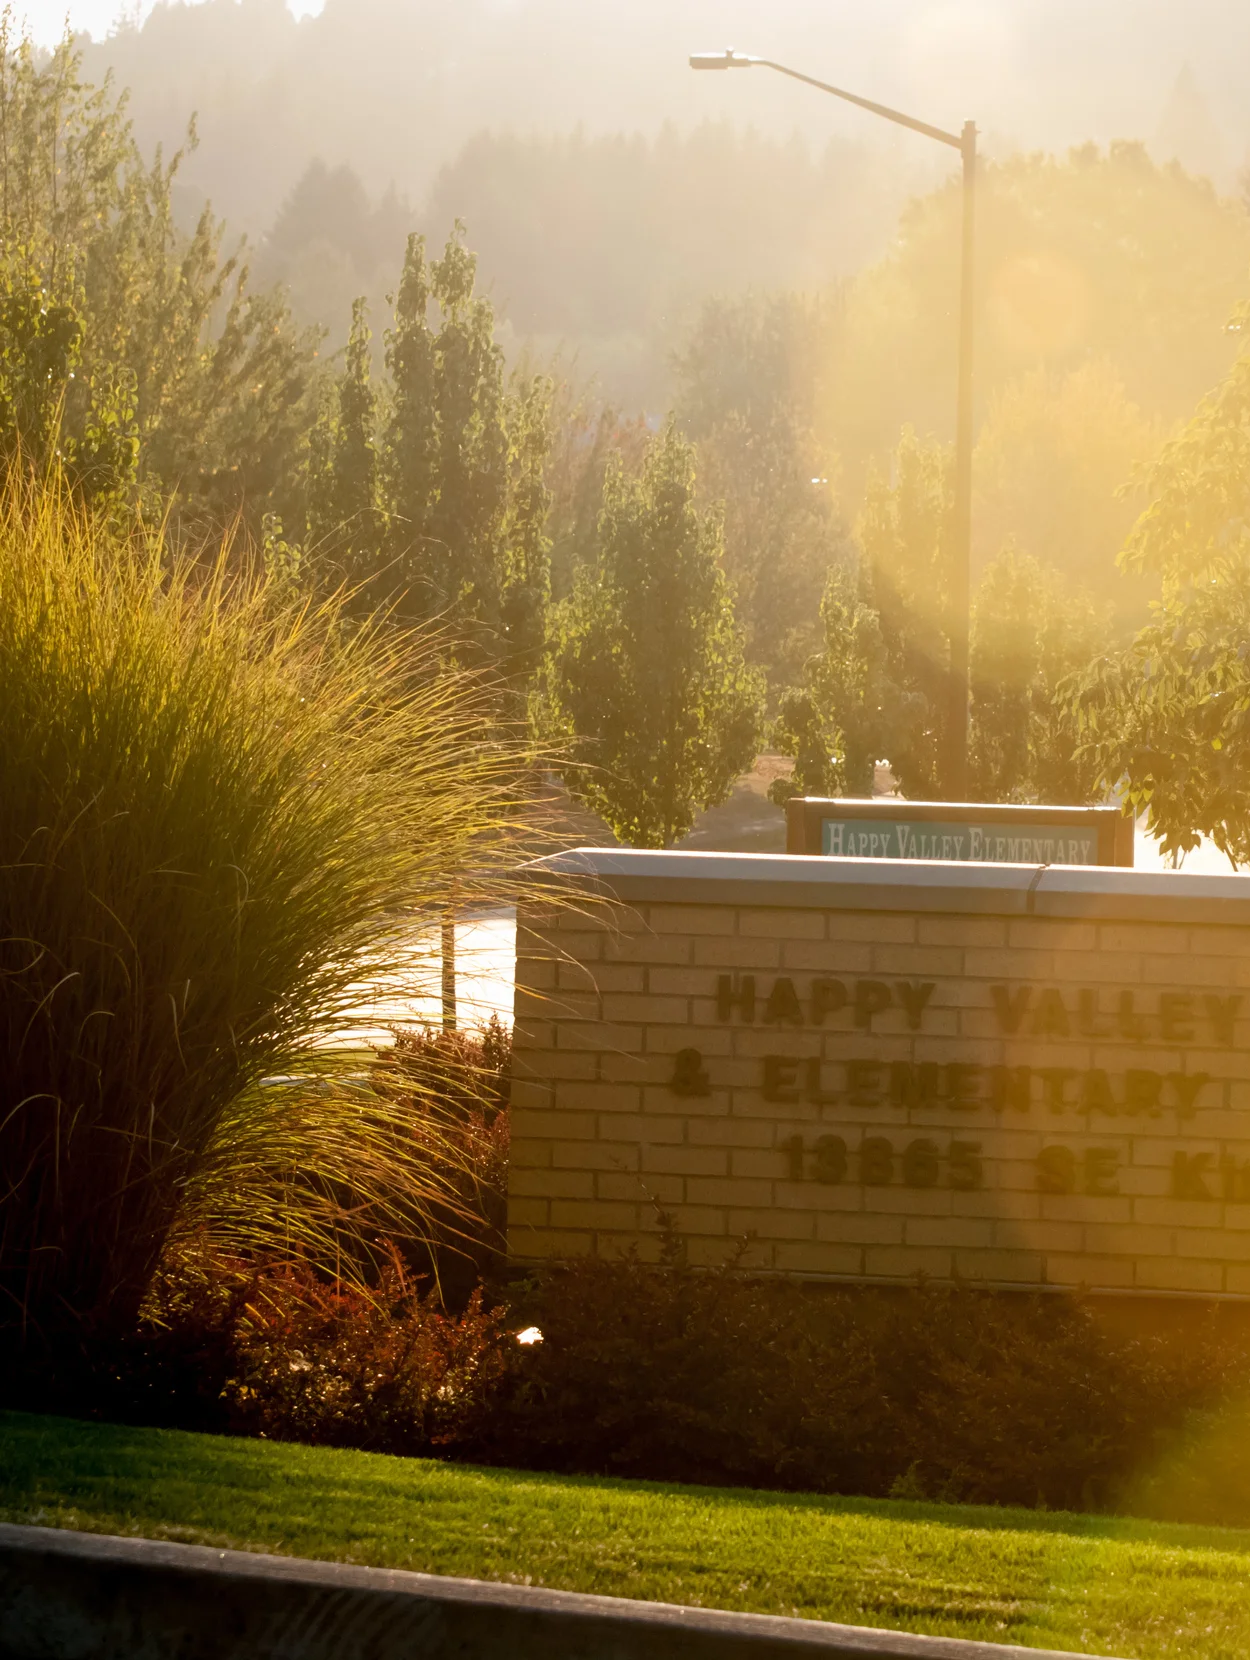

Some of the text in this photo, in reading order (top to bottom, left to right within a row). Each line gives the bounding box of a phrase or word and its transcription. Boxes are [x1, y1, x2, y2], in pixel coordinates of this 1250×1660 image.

[715, 973, 936, 1030] HAPPY
[989, 984, 1244, 1044] VALLEY
[671, 1047, 711, 1098] &
[762, 1055, 1211, 1120] ELEMENTARY
[1035, 1145, 1121, 1196] SE
